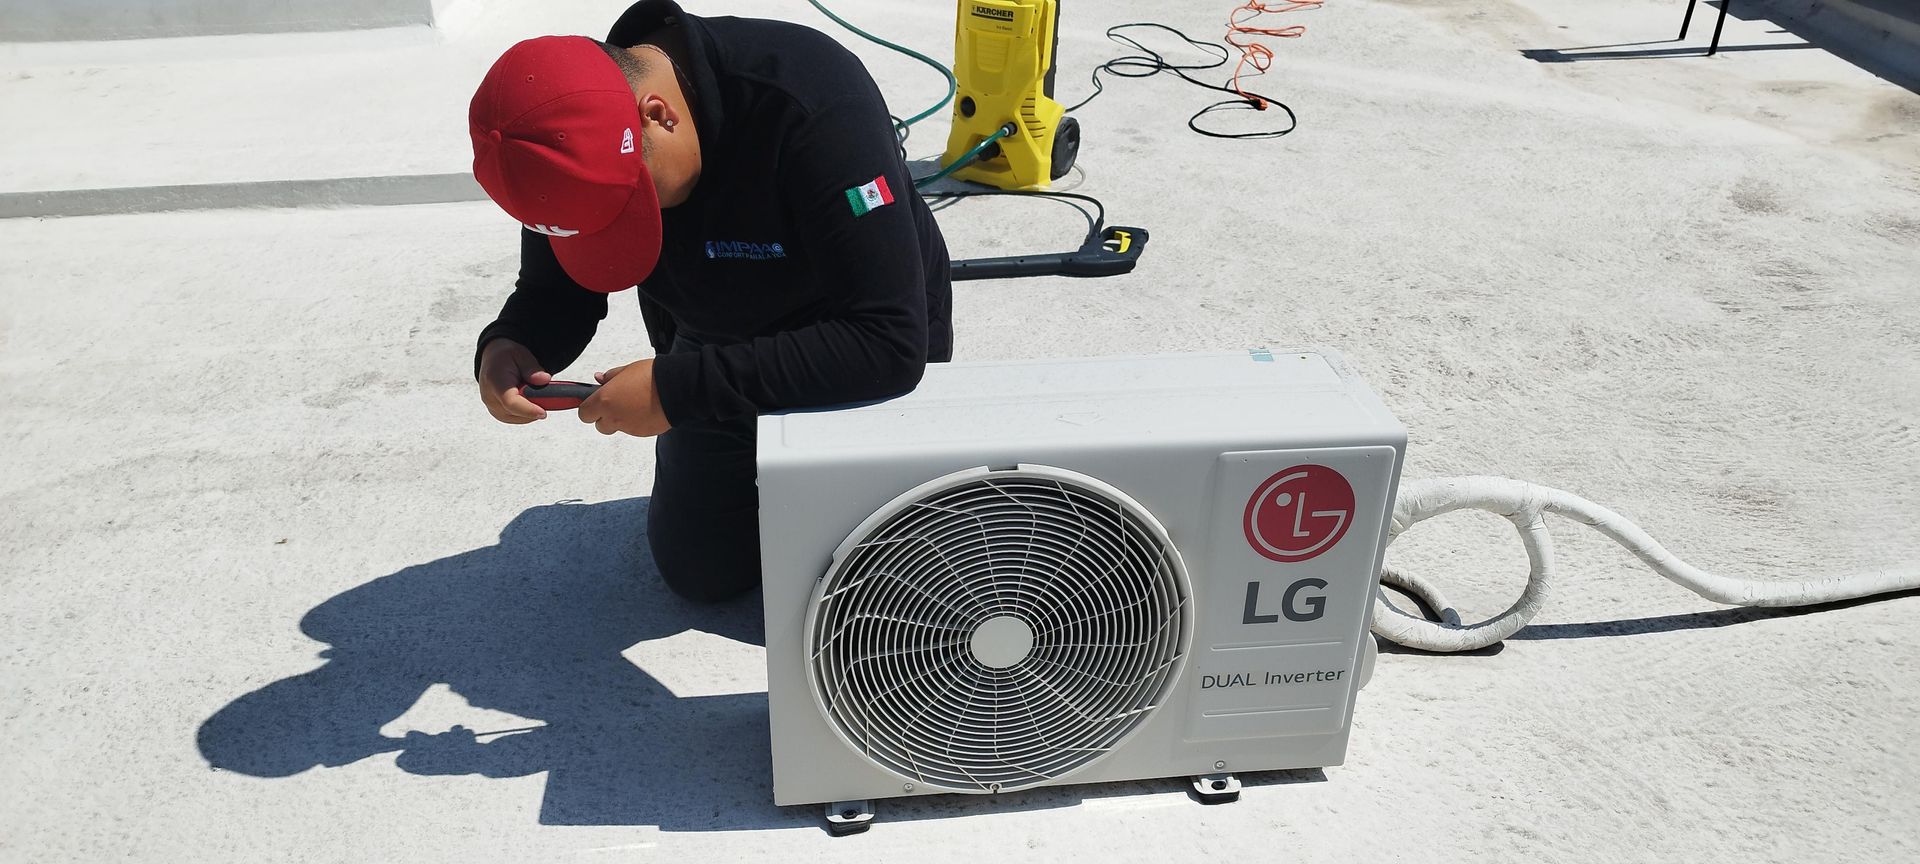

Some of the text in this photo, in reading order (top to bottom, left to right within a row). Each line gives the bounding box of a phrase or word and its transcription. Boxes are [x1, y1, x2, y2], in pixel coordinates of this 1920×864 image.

[1251, 471, 1347, 556] LG
[1242, 577, 1329, 625] LG
[1201, 670, 1345, 689] DUAL Inverter
